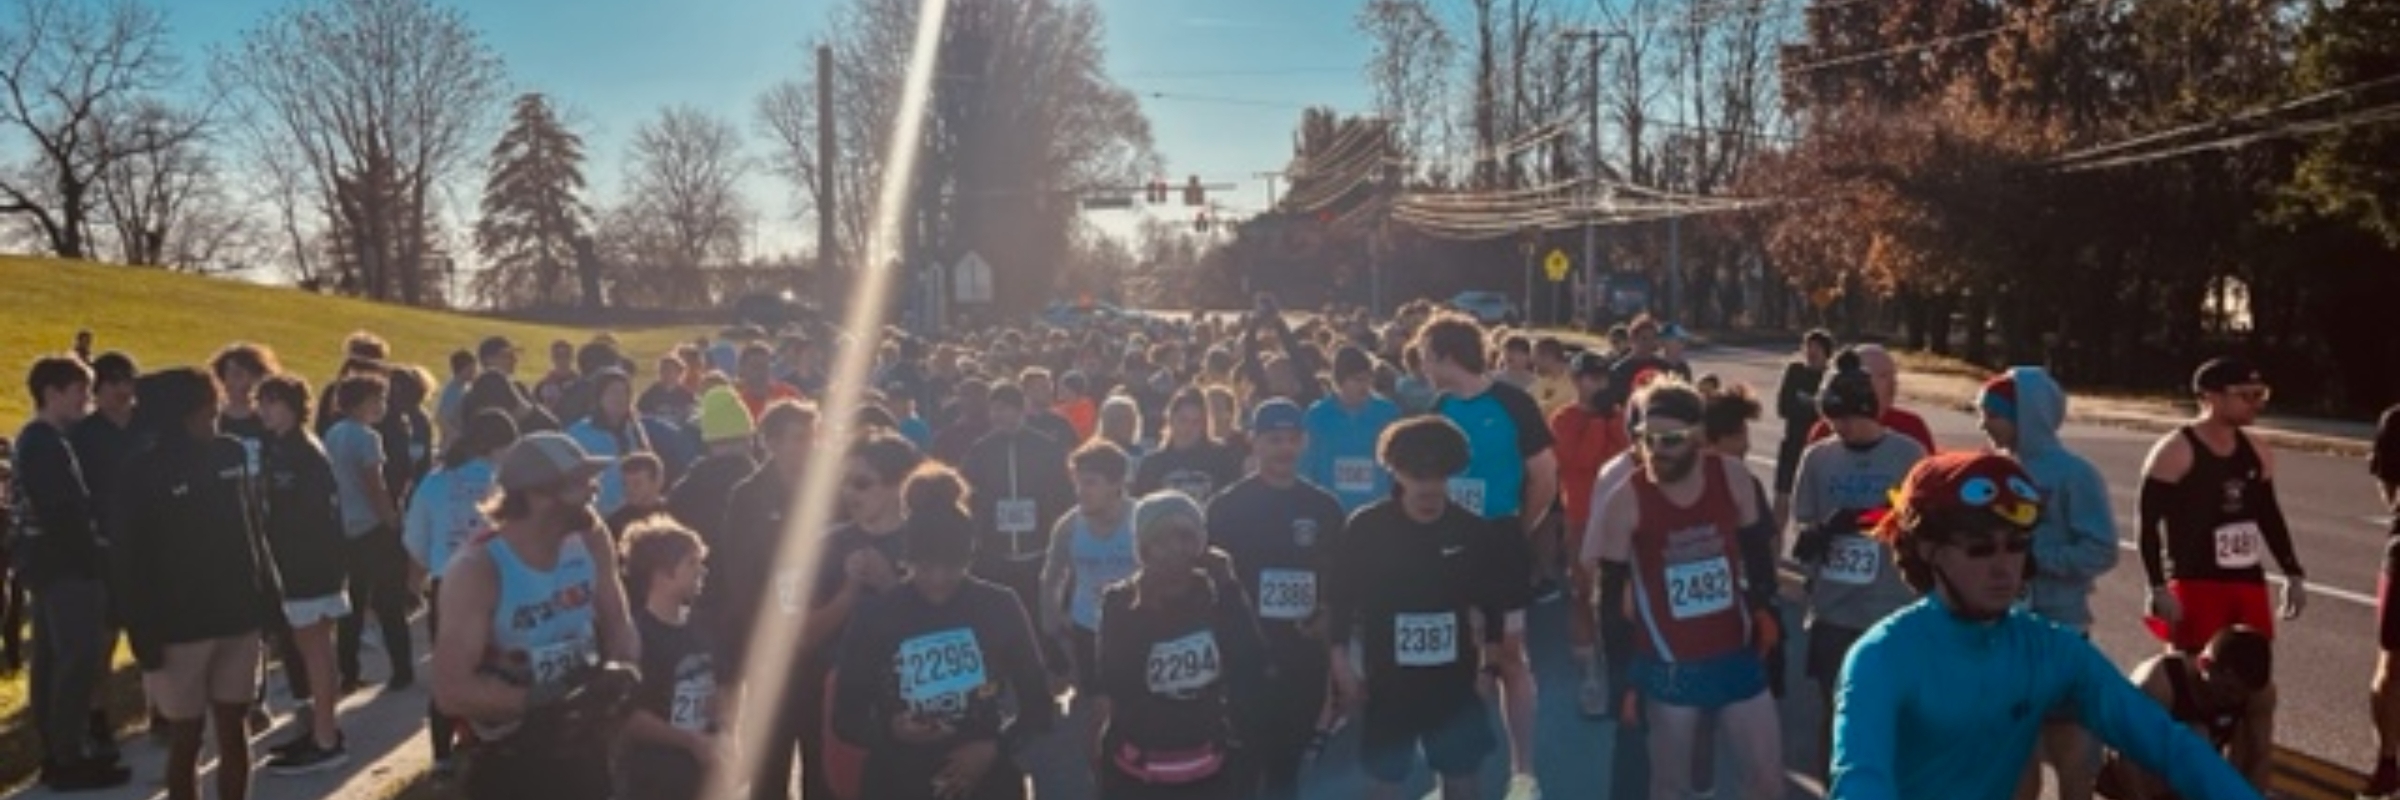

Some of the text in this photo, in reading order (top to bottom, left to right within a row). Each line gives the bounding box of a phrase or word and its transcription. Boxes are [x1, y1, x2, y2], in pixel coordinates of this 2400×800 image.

[1401, 624, 1452, 653] 2387
[911, 641, 979, 685] 2295
[1151, 644, 1216, 684] 2294
